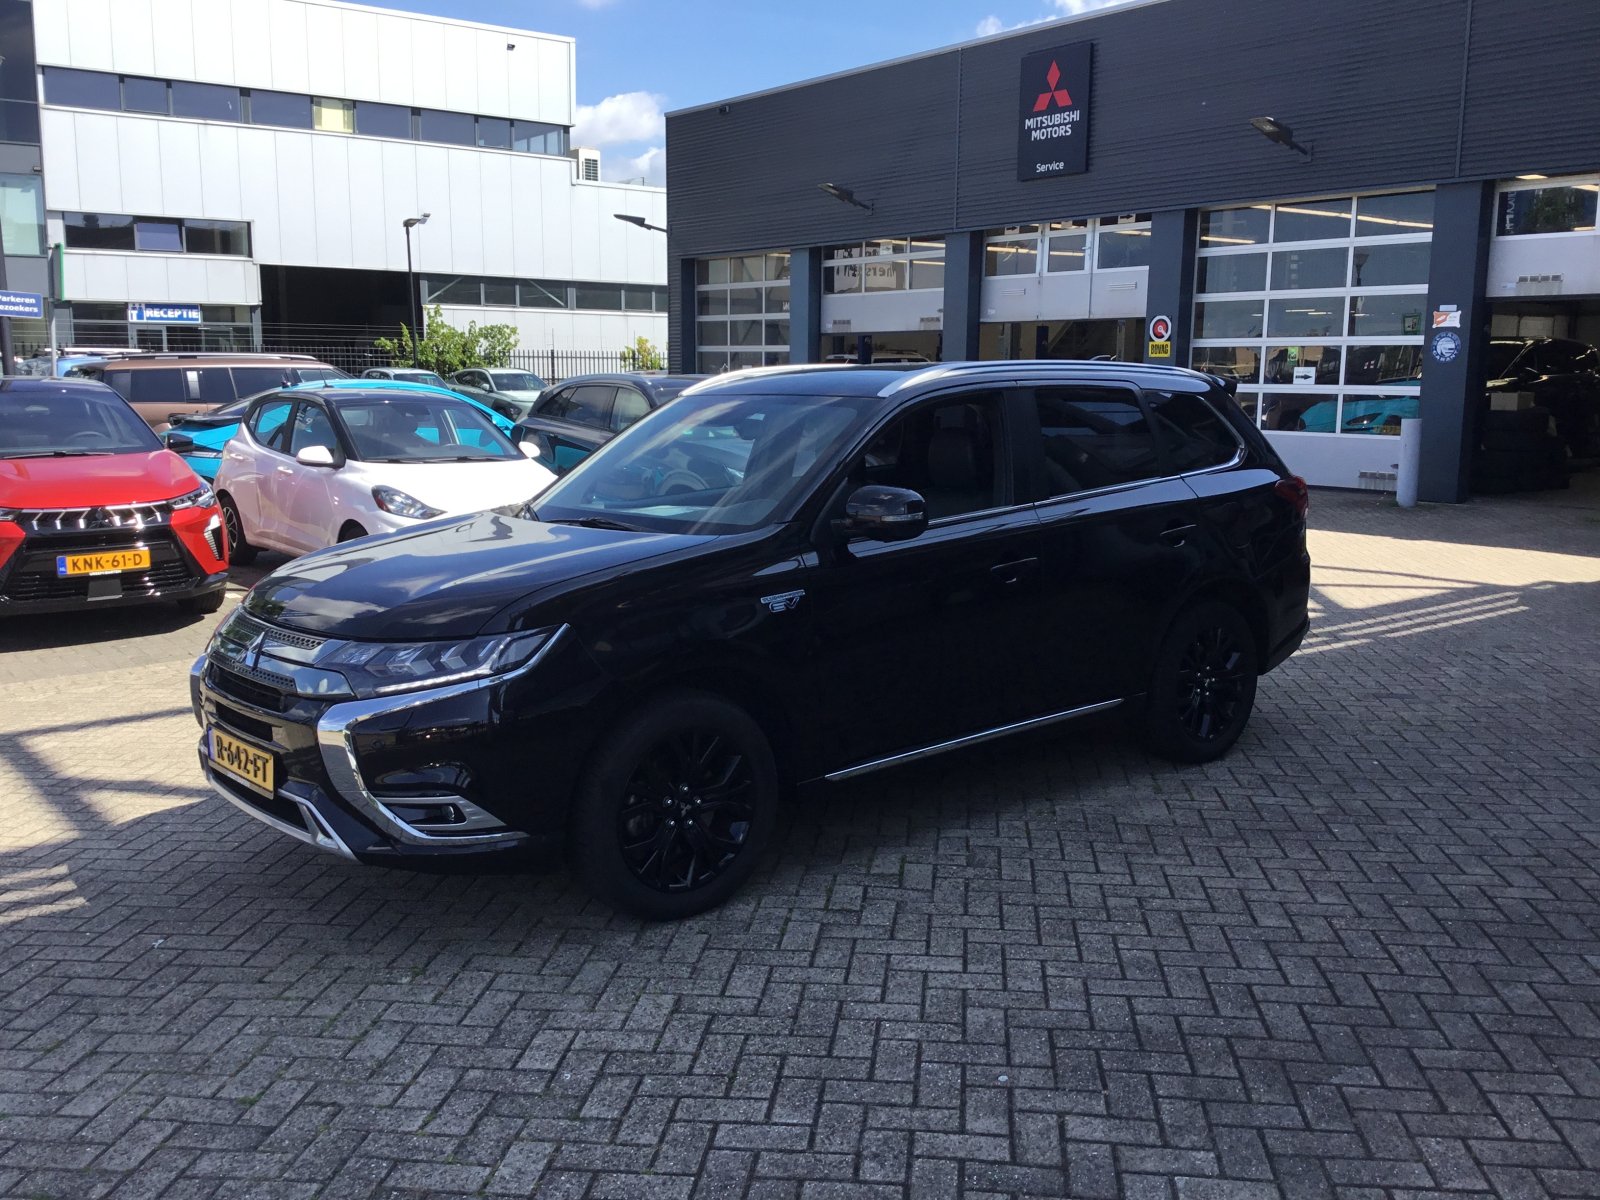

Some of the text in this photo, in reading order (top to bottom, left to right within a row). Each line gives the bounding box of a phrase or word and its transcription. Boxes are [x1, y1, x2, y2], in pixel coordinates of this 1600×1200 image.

[1025, 110, 1080, 130] MITSUBISHI
[1031, 124, 1072, 141] MOTORS
[1036, 161, 1065, 173] Service
[0, 304, 39, 313] ezoekers
[145, 308, 199, 319] RECEPTIE
[1150, 343, 1169, 355] BOVAG
[72, 553, 143, 572] KNK-61-D
[216, 735, 269, 783] R-642-FT
